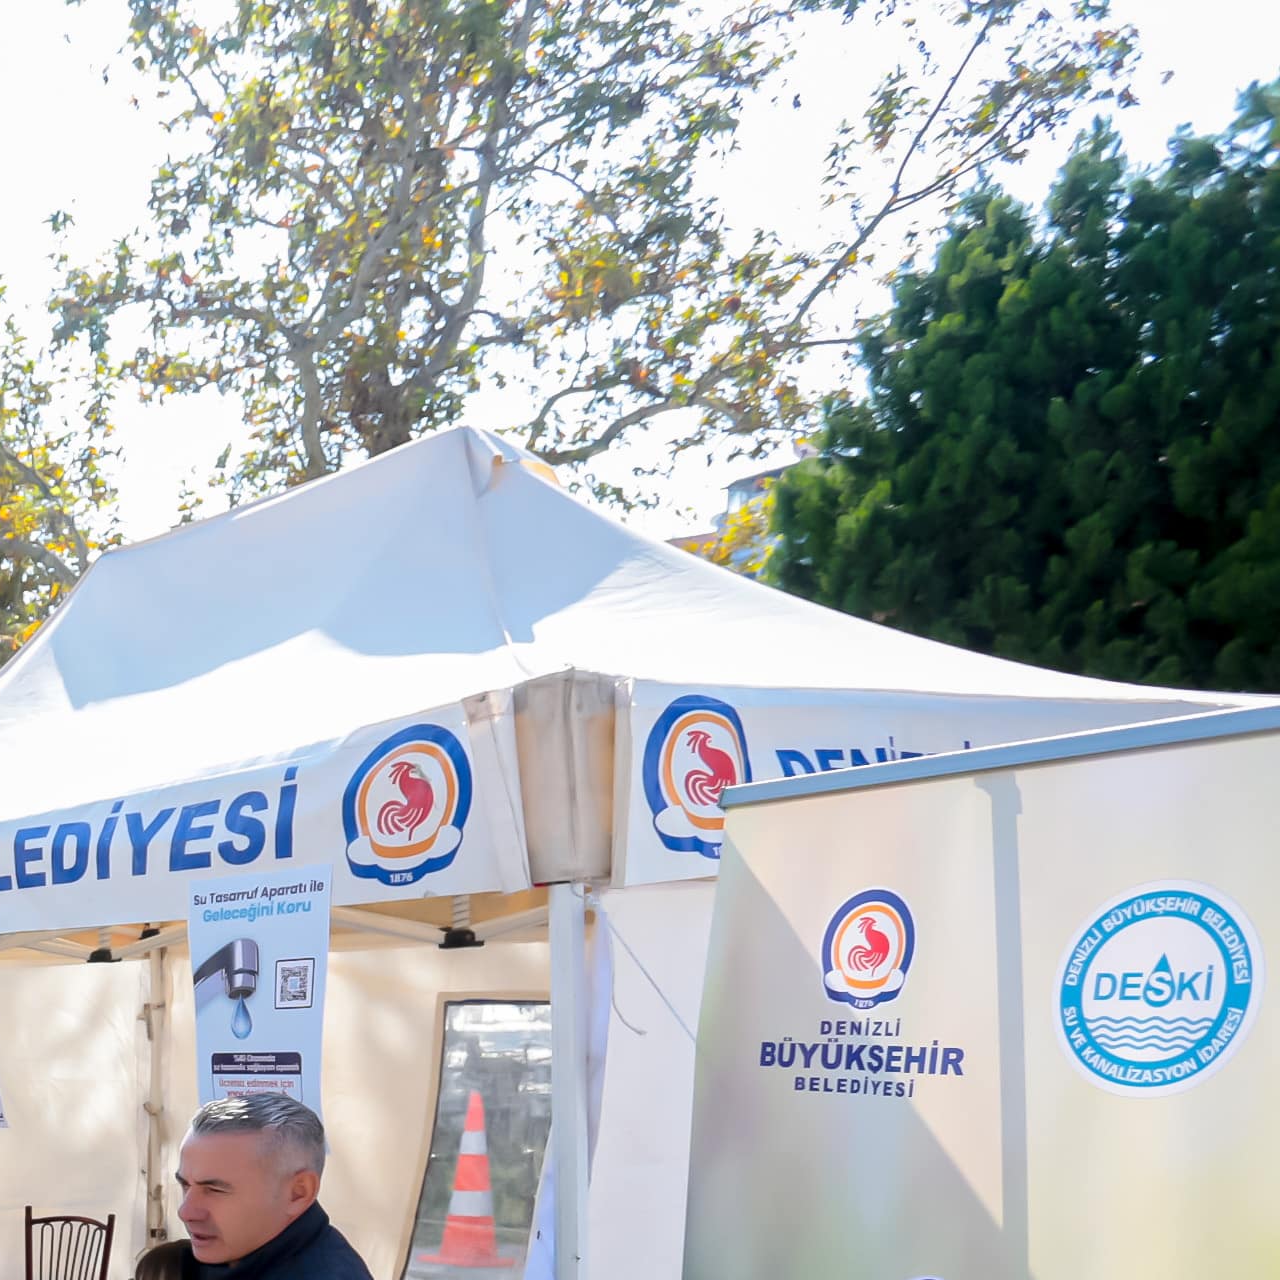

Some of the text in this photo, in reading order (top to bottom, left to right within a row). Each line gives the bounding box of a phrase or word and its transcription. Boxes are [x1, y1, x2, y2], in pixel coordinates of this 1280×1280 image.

[193, 880, 324, 905] Su Tasarruf Aparatı ile
[203, 901, 311, 922] Geleceğini Koru
[1065, 896, 1250, 987] DENİZLİ BÜYÜKŞEHİR BELEDİYESİ
[1094, 965, 1214, 1003] DESKİ
[820, 1018, 900, 1036] DENİZLİ
[760, 1037, 965, 1076] BÜYÜKŞEHİR
[1064, 1006, 1243, 1082] SU VE KANALİZASYON İDARESİ
[794, 1076, 914, 1098] BELEDİYESİ
